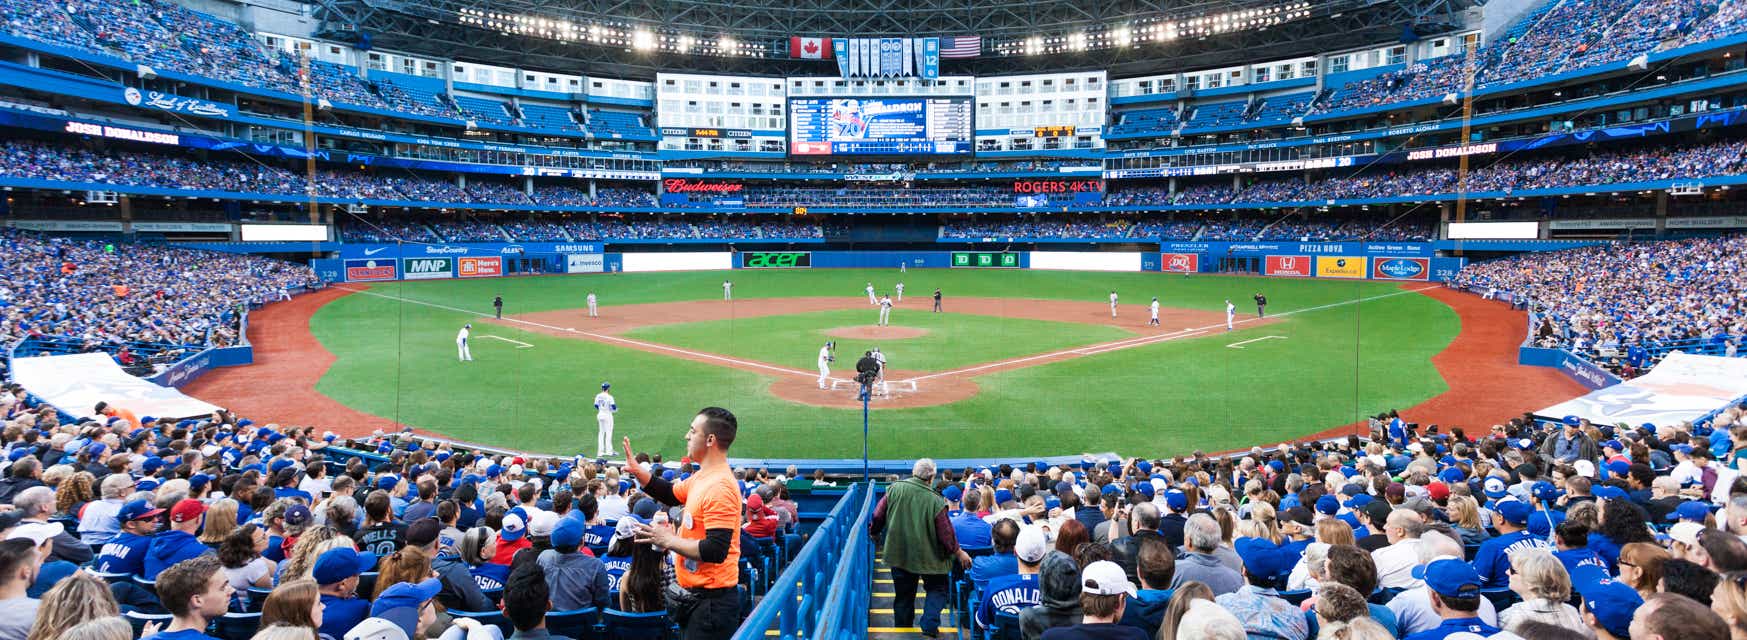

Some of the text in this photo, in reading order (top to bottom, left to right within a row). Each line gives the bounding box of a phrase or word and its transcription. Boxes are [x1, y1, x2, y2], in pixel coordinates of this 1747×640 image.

[926, 56, 937, 65] 12
[65, 121, 179, 145] JOSH DONALDSON
[1407, 143, 1497, 160] JOSH DONALDSON
[665, 179, 742, 193] Budweiser
[1014, 181, 1105, 193] ROGERS 4K TV
[411, 260, 445, 272] MNP
[748, 253, 806, 267] acer
[981, 256, 991, 264] TD
[362, 529, 397, 544] WELLS
